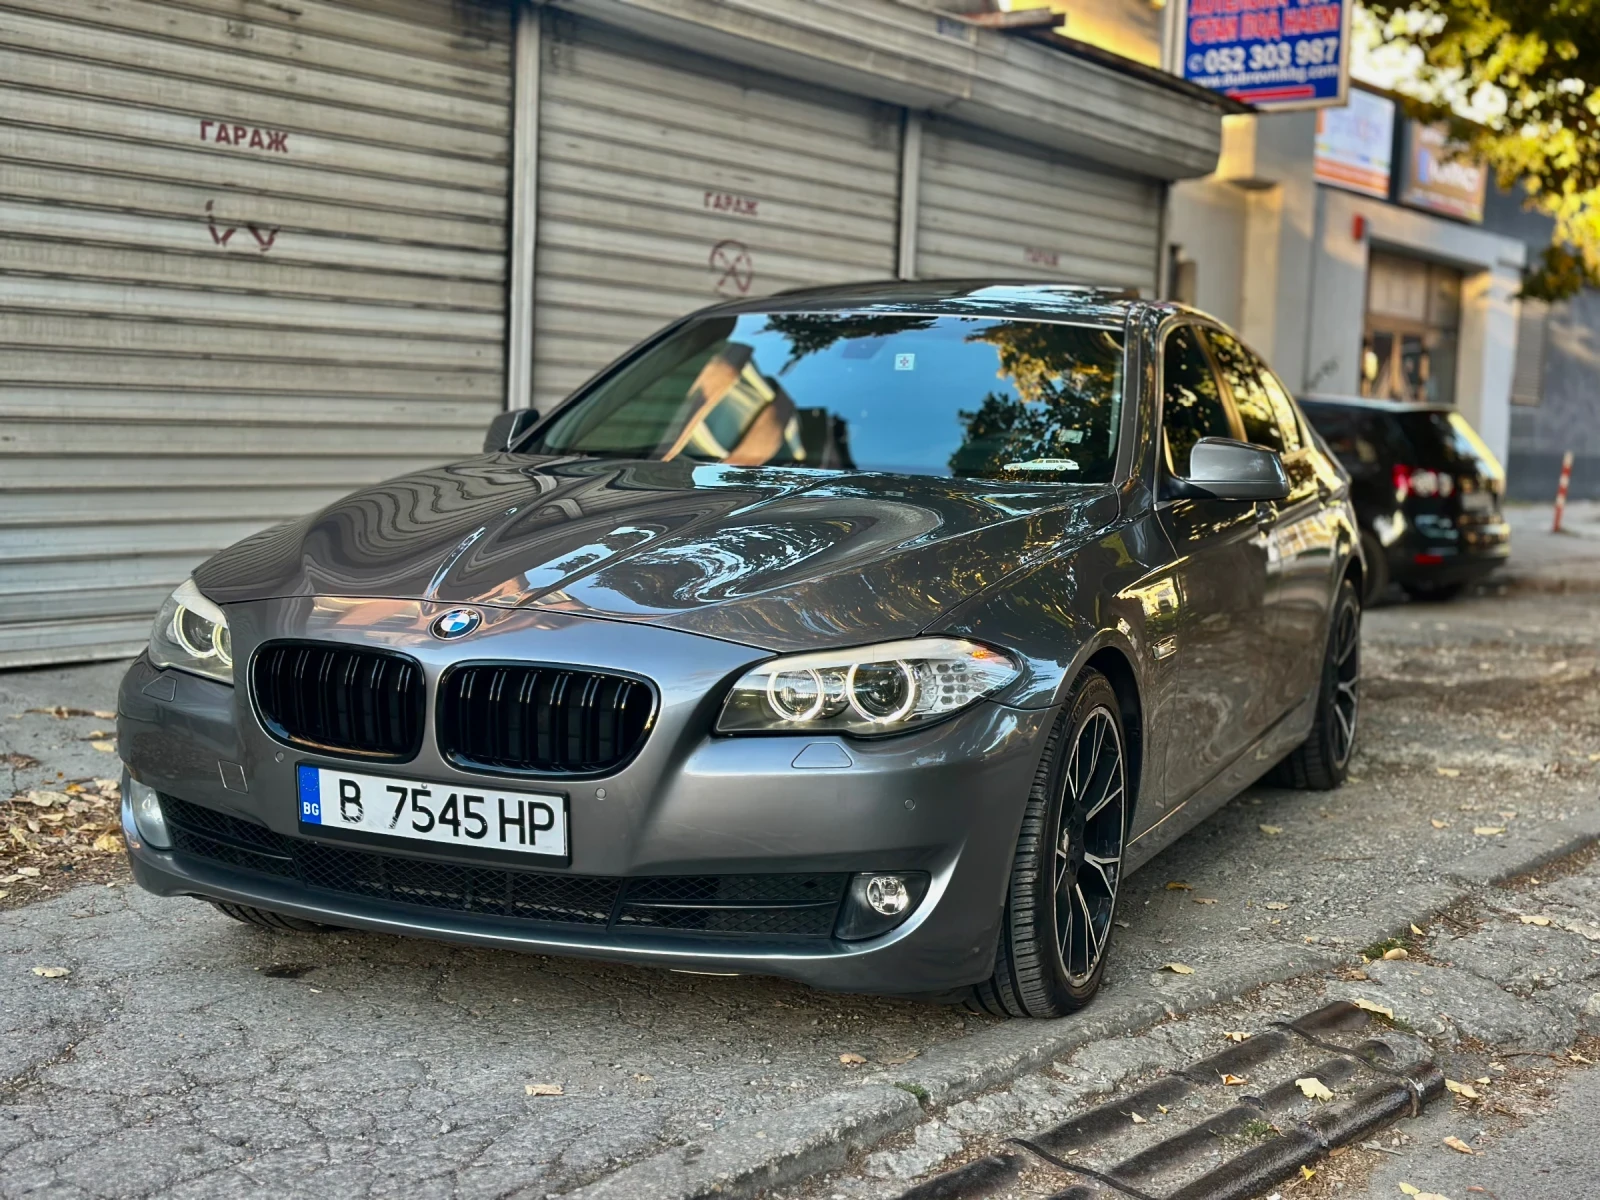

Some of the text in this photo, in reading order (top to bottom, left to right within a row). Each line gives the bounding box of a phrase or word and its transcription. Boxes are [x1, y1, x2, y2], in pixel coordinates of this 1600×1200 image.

[1204, 46, 1246, 74] 052
[1248, 42, 1292, 69] 303
[200, 120, 289, 153] ГАРАЖ
[704, 192, 758, 216] ГАРАЖ
[303, 801, 320, 817] BG
[339, 778, 555, 846] B 7545 HP
